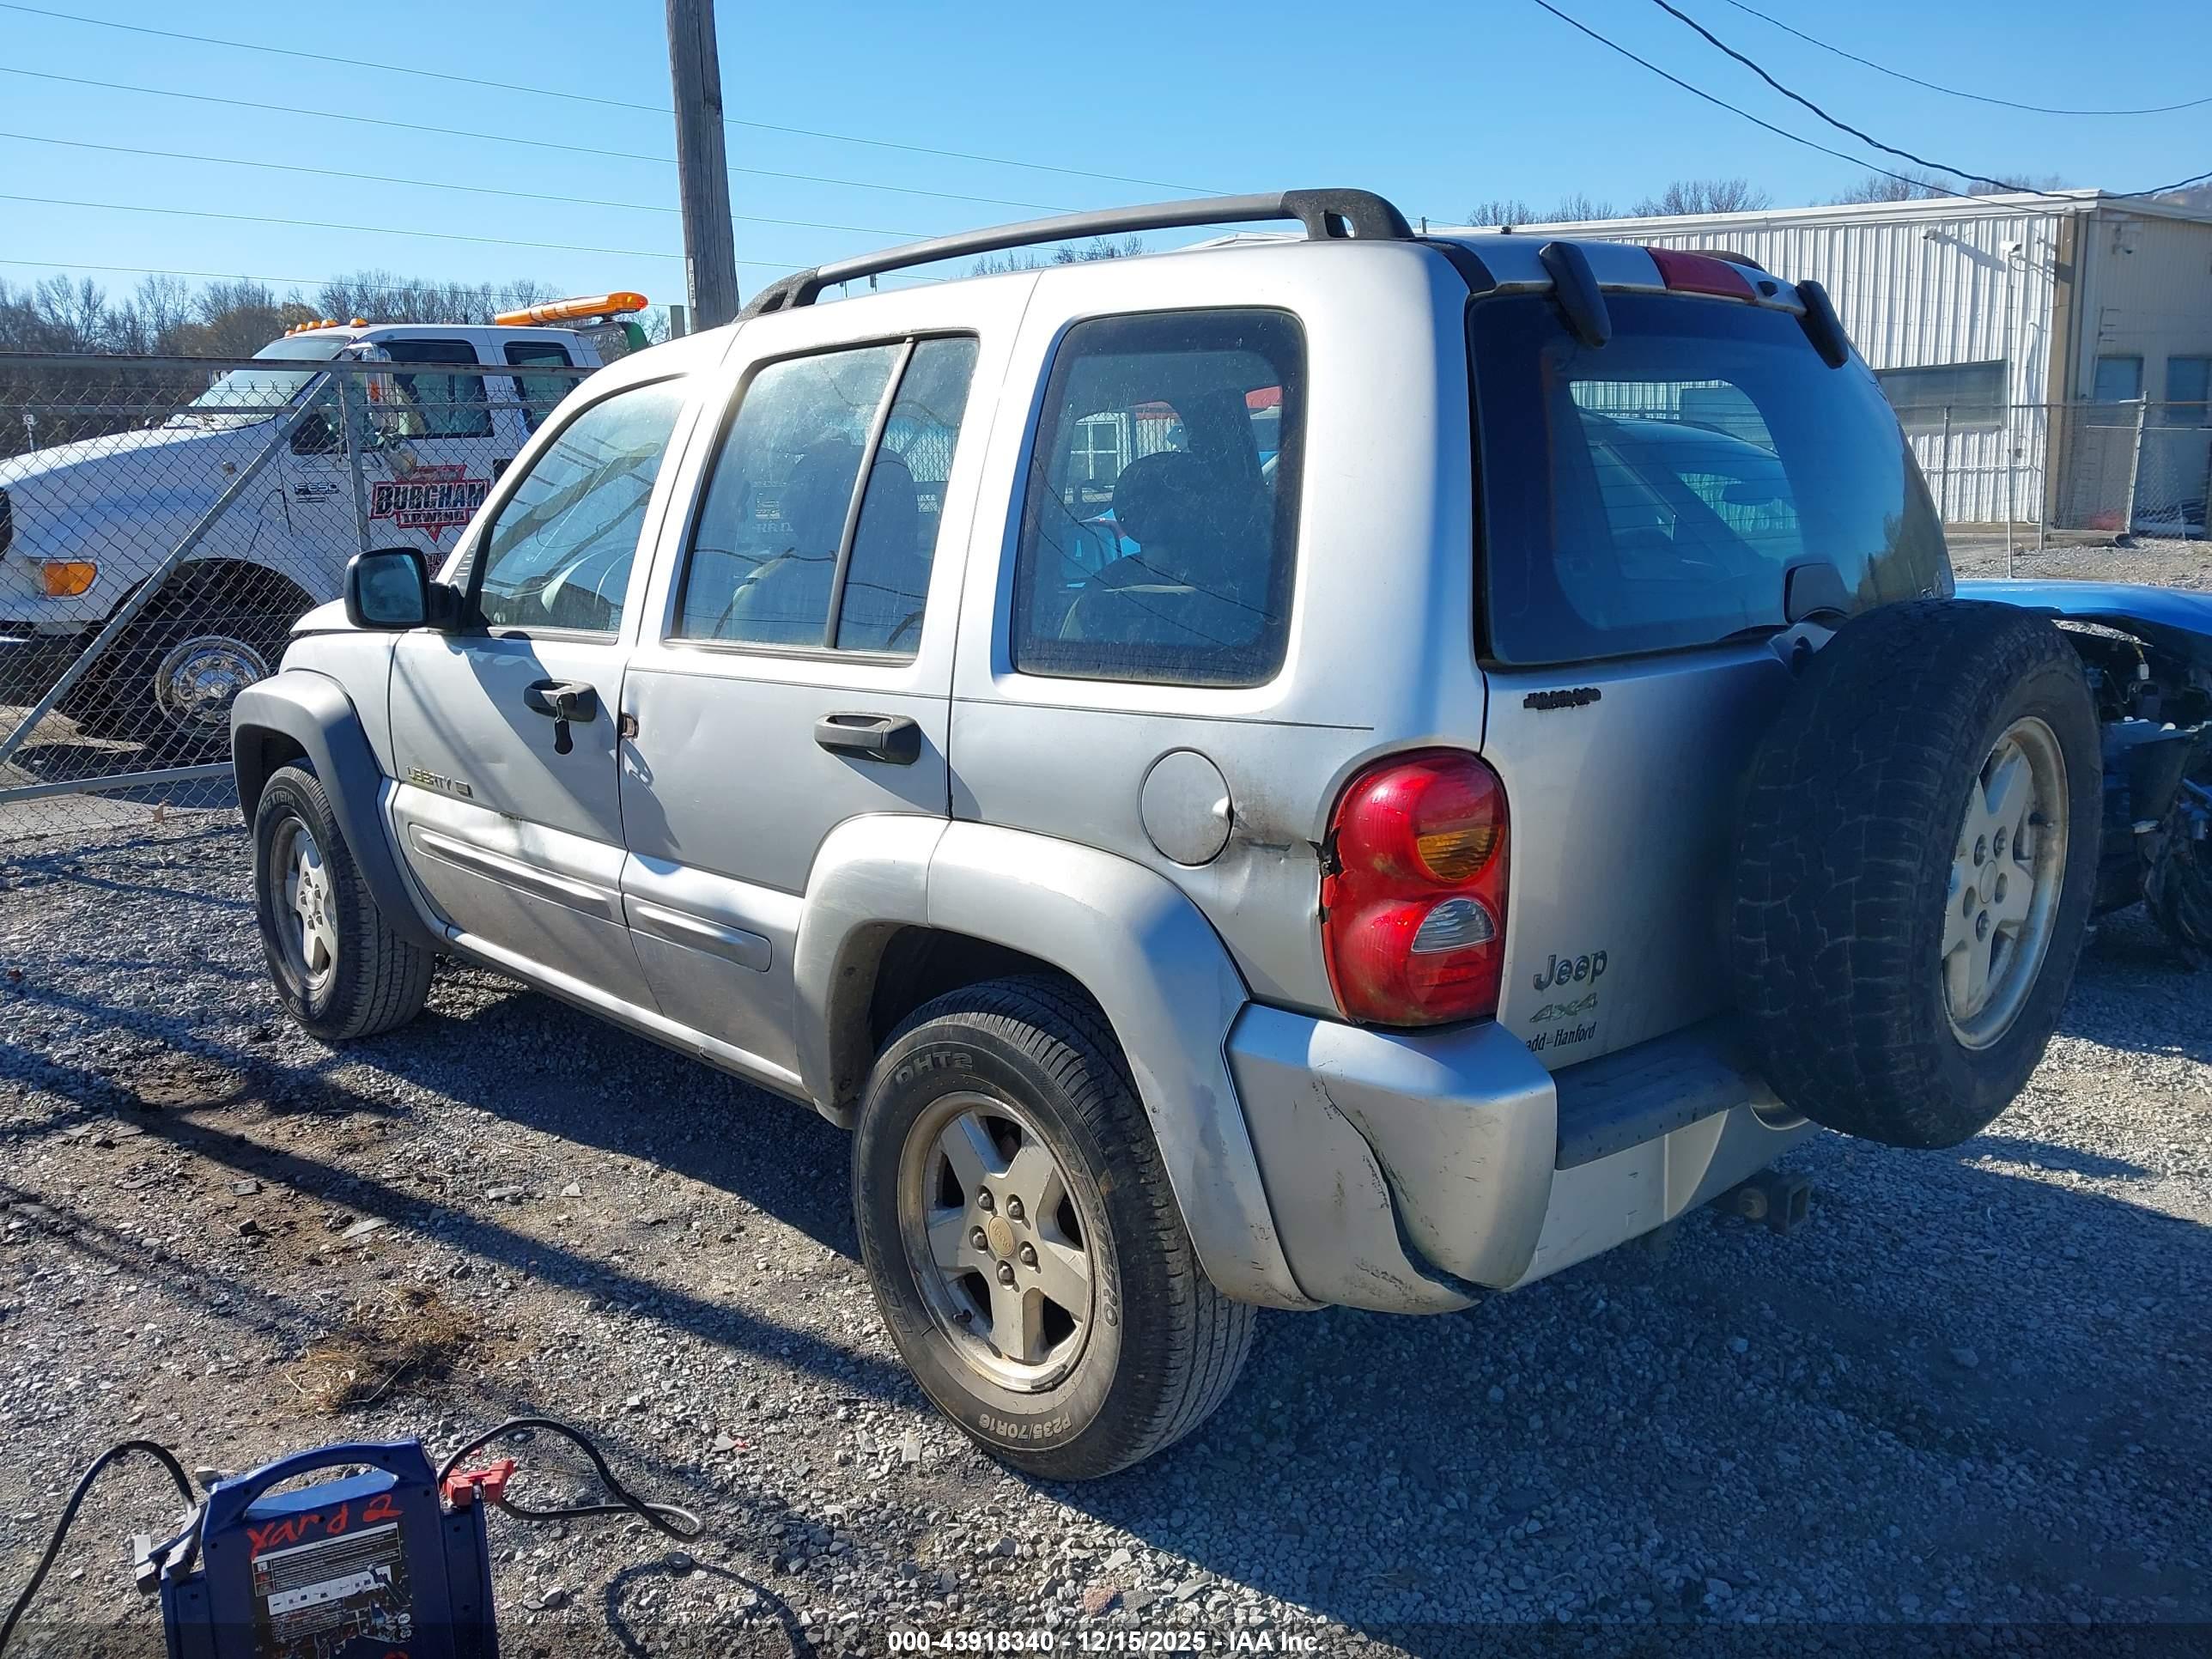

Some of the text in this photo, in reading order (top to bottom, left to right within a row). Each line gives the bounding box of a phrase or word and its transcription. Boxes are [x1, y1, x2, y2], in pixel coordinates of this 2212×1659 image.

[1533, 950, 1607, 990] Jeep
[979, 1411, 1072, 1441] P235/70R16
[362, 1493, 404, 1522] 2
